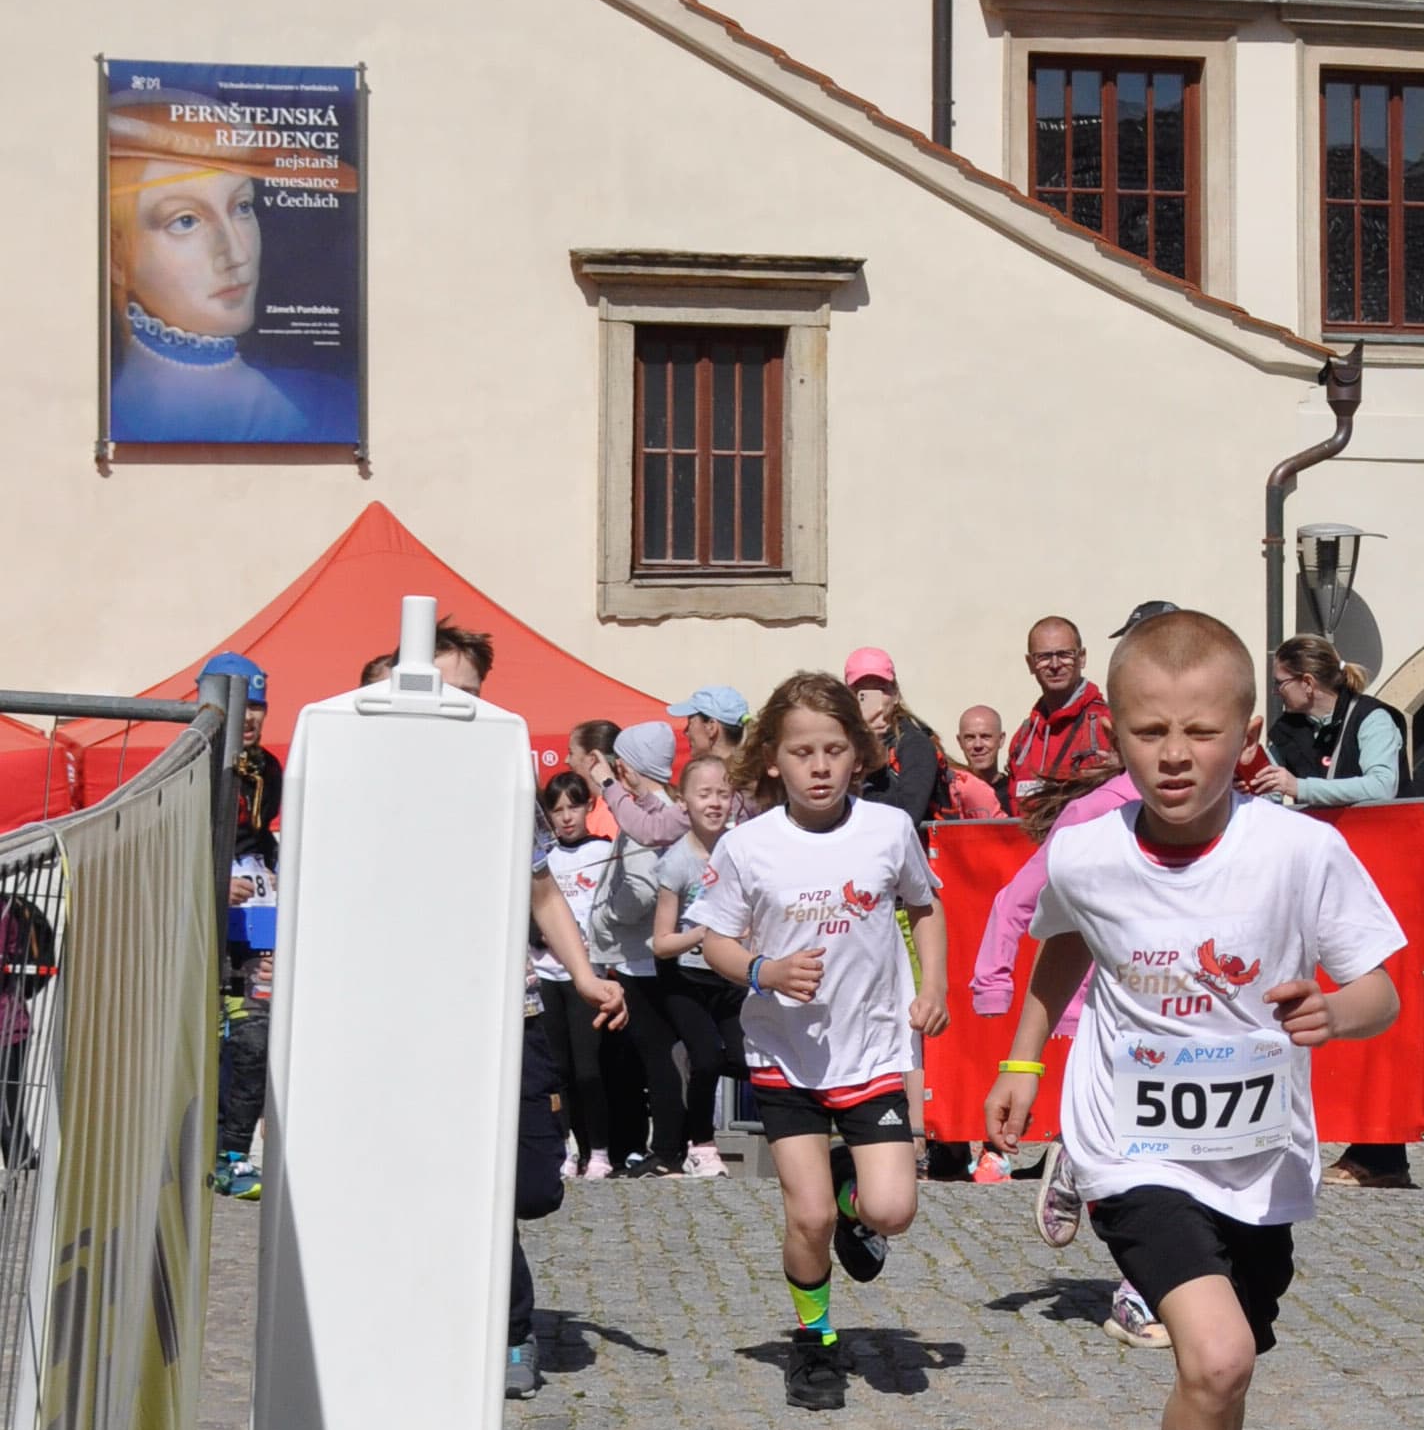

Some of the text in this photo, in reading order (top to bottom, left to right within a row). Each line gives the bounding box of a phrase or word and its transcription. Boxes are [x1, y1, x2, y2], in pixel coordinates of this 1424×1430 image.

[169, 102, 339, 127] PERNŠTEJNSKÁ
[215, 128, 340, 150] REZIDENCE
[274, 154, 339, 171] nejstarší
[264, 175, 339, 189] renesance
[263, 189, 340, 209] v Čechách
[799, 889, 832, 902] PVZP
[782, 902, 841, 923] Fénix
[816, 919, 851, 936] run
[1131, 950, 1180, 966] PVZP
[1113, 962, 1200, 994] Fénix
[1160, 993, 1213, 1017] run
[1195, 1047, 1235, 1060] PVZP
[1136, 1073, 1275, 1130] 5077
[1140, 1142, 1170, 1153] PVZP
